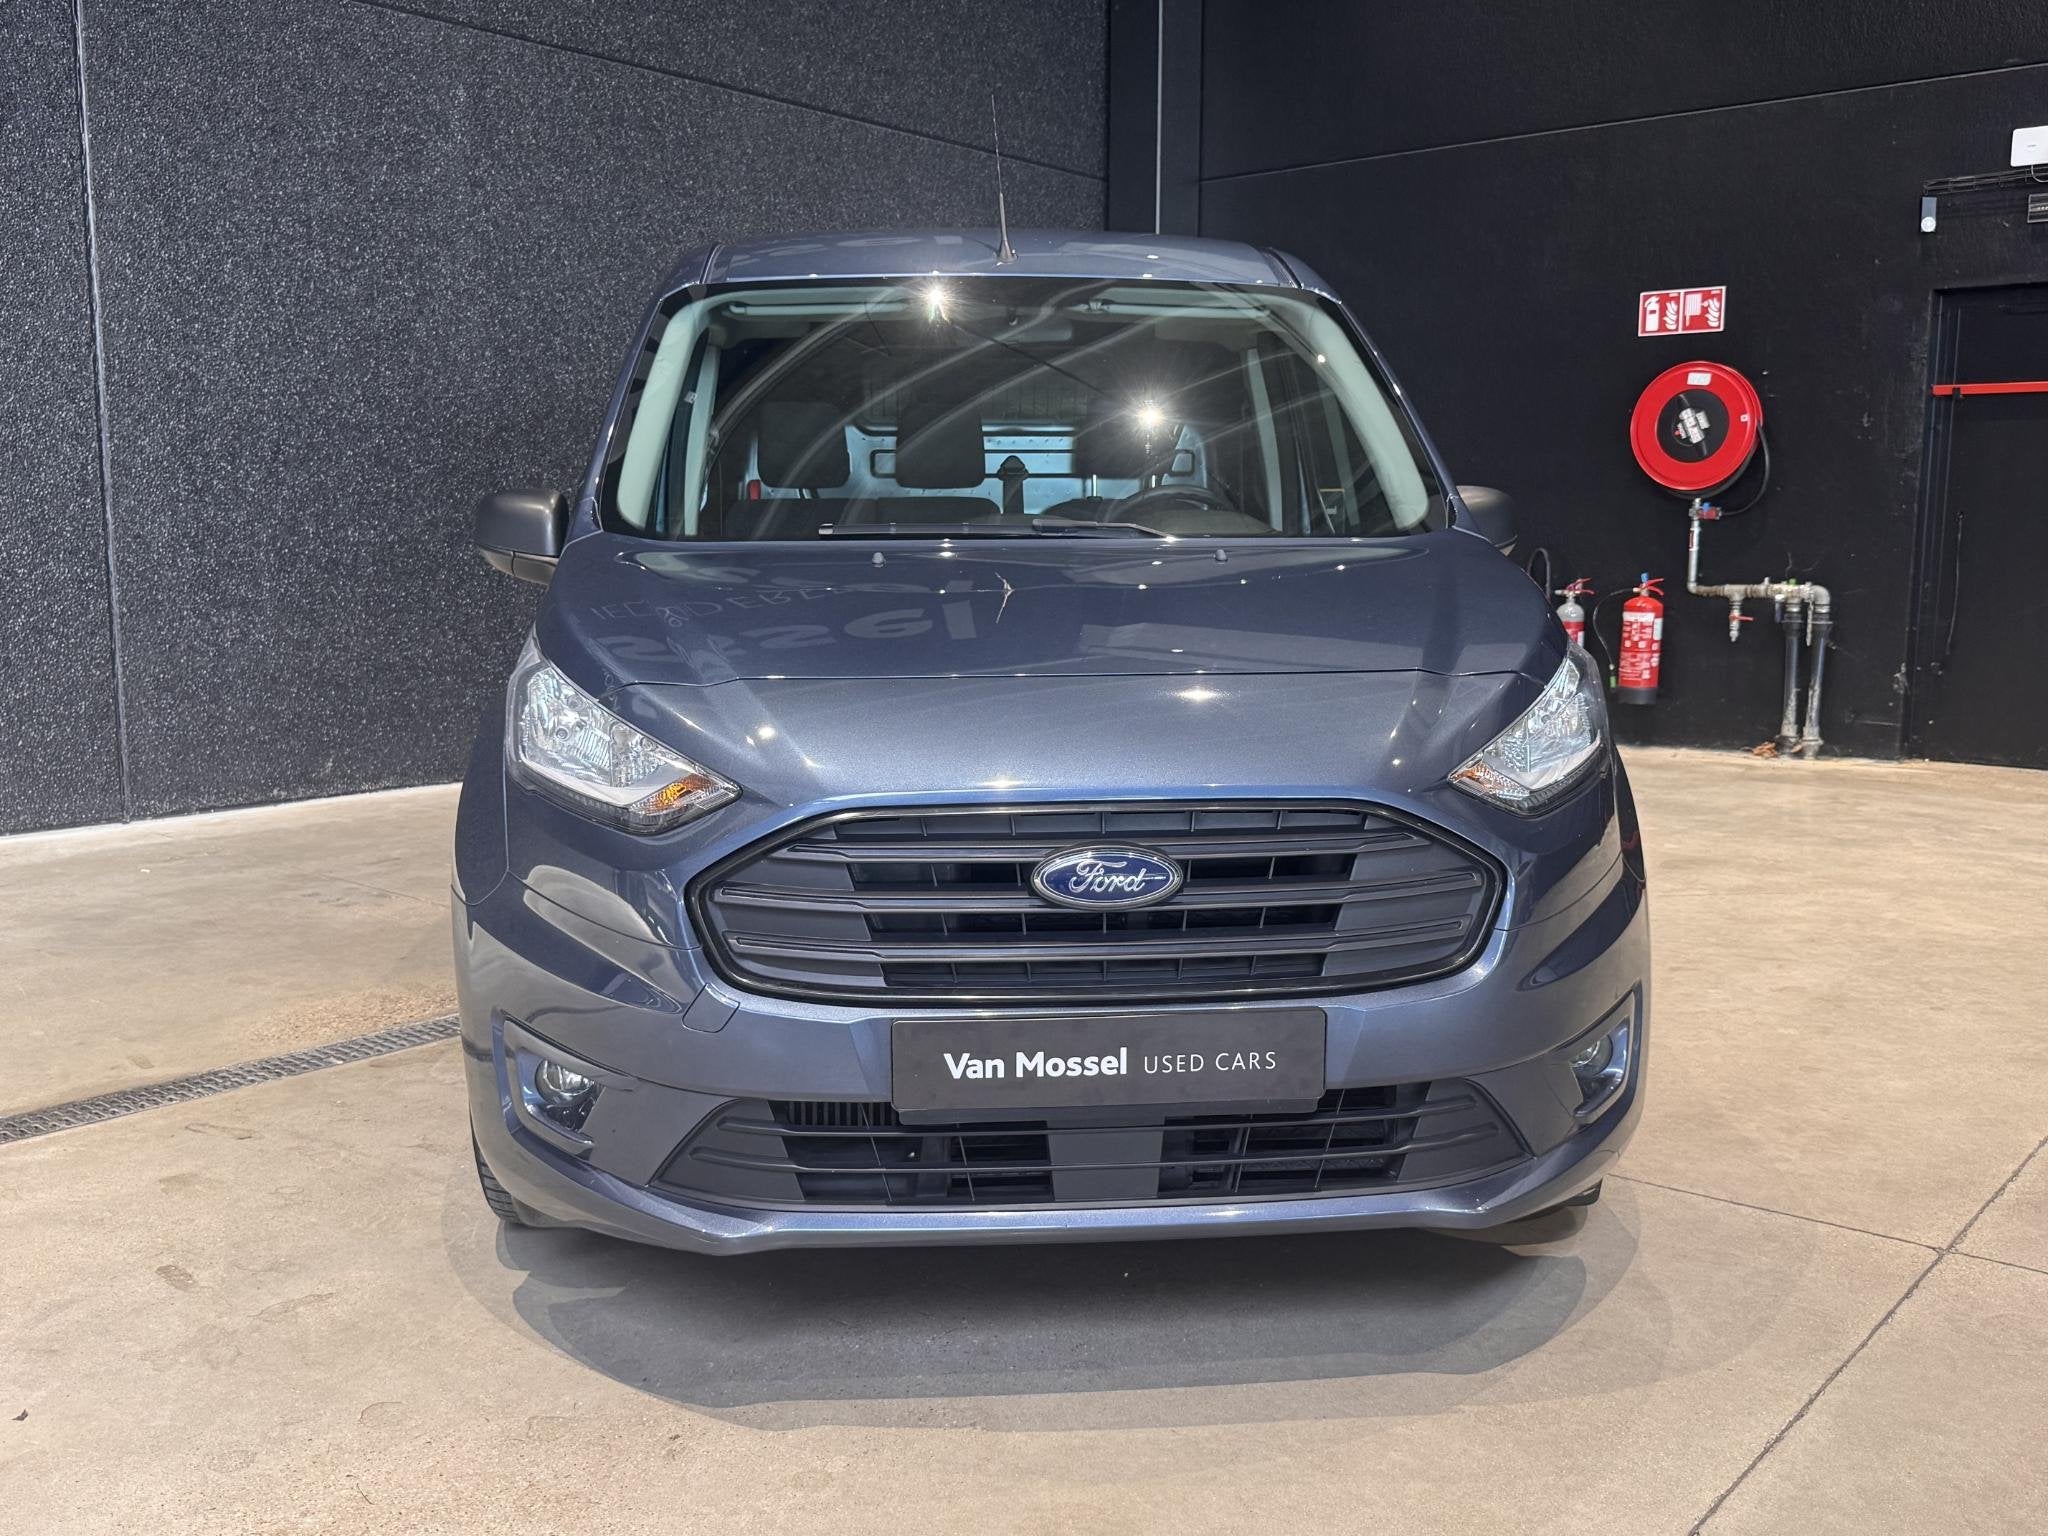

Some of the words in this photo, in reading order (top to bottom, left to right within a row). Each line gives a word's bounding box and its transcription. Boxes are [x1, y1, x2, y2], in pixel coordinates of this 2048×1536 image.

[1068, 858, 1166, 894] Ford
[944, 1053, 1004, 1079] Van
[1016, 1047, 1127, 1077] Mossel
[1145, 1054, 1204, 1073] USED
[1216, 1052, 1275, 1070] CARS
